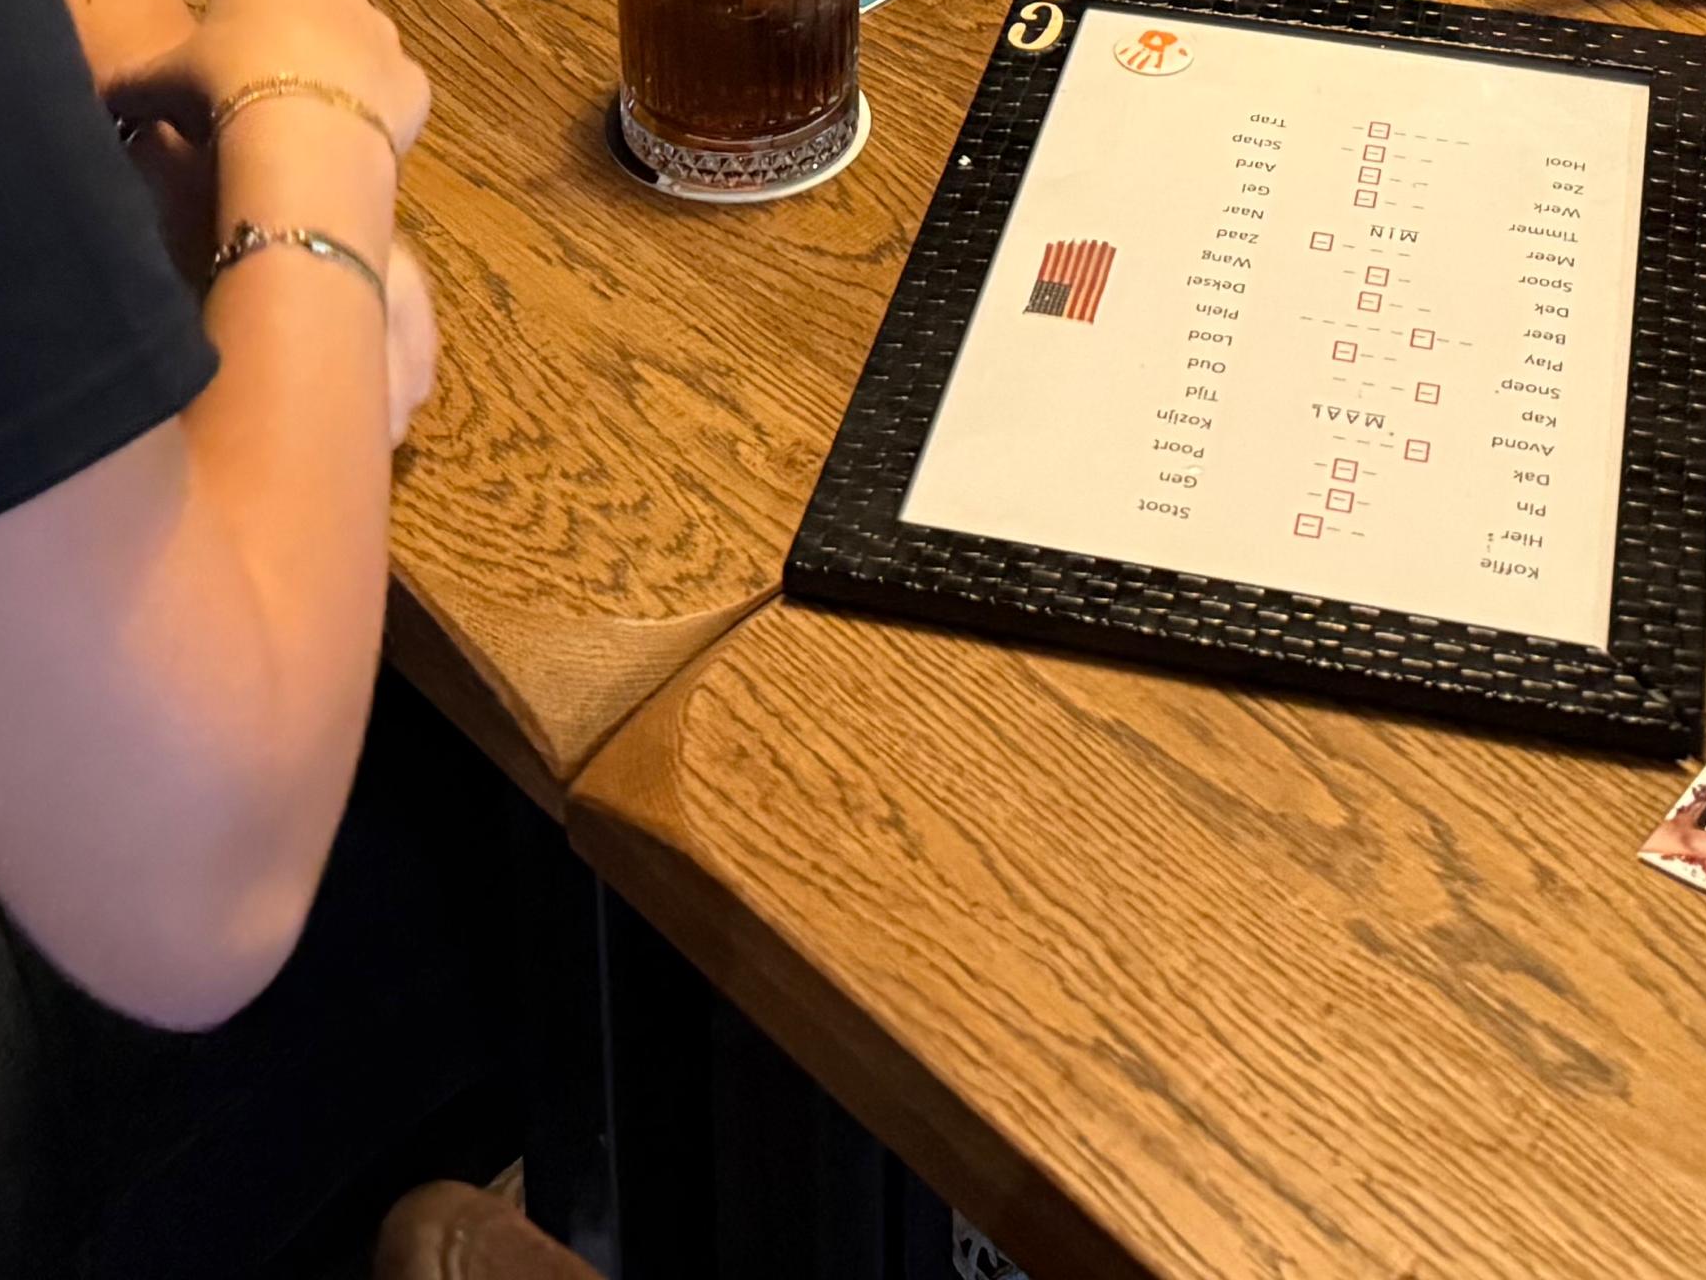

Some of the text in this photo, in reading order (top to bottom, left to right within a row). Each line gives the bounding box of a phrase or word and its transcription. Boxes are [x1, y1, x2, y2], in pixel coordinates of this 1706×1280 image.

[1250, 113, 1287, 128] Trap
[1232, 134, 1282, 151] Schap
[1235, 158, 1276, 173] Aard
[1241, 182, 1271, 196] Gel
[1552, 180, 1585, 196] Zee
[1222, 204, 1265, 220] Naar
[1533, 202, 1582, 220] Werk
[1216, 227, 1260, 244] Zaad
[1508, 223, 1579, 243] Timmer
[1201, 249, 1252, 269] Wang
[1526, 250, 1576, 268] Meer
[1186, 275, 1246, 294] Deksel
[1518, 275, 1573, 293] Spoor
[1196, 302, 1239, 321] Plein
[1534, 302, 1571, 319] Dek
[1188, 329, 1233, 347] Lood
[1523, 328, 1567, 346] Beer
[1187, 357, 1227, 374] Oud
[1524, 354, 1564, 372] Play
[1185, 385, 1219, 403] Tijd
[1500, 379, 1562, 400] Snoep
[1156, 408, 1213, 429] Kozijn
[1521, 411, 1558, 428] Kap
[1153, 439, 1205, 459] Poort
[1491, 435, 1555, 457] Avond
[1159, 471, 1198, 489] Gen
[1512, 469, 1551, 487] Dak
[1137, 498, 1192, 520] Stoot
[1500, 529, 1544, 548] Hier
[1480, 557, 1541, 580] Koffie
